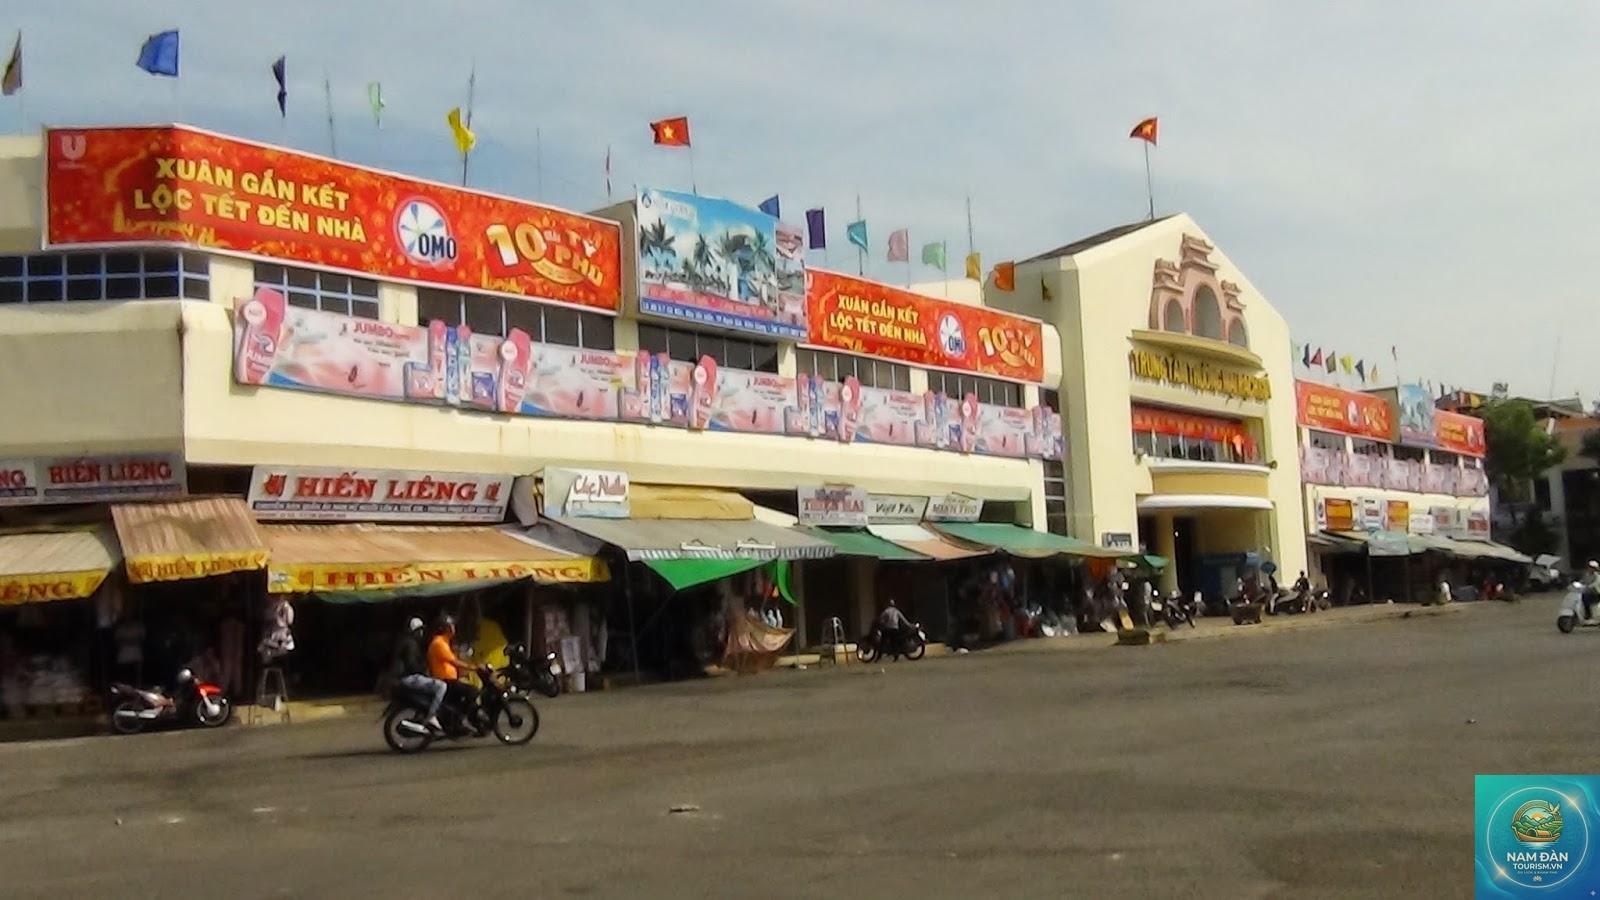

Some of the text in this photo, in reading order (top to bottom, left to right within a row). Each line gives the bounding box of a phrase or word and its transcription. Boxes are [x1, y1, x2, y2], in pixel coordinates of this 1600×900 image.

[155, 158, 350, 212] XUÂN GẮN KẾT
[134, 183, 367, 243] LỘC TẾT ĐẾN NHÀ
[418, 234, 457, 260] OMO
[486, 223, 547, 267] 10
[838, 295, 870, 315] XUÂN
[898, 305, 919, 325] KẾT
[353, 322, 393, 338] JUMBO
[830, 312, 854, 332] LỘC
[855, 316, 878, 336] TẾT
[904, 326, 927, 346] NHÀ
[978, 327, 1008, 357] 10
[580, 354, 609, 367] JUMBO
[293, 472, 478, 501] HIẾN LIÊNG
[324, 562, 589, 586] HIẾN LIÊNG
